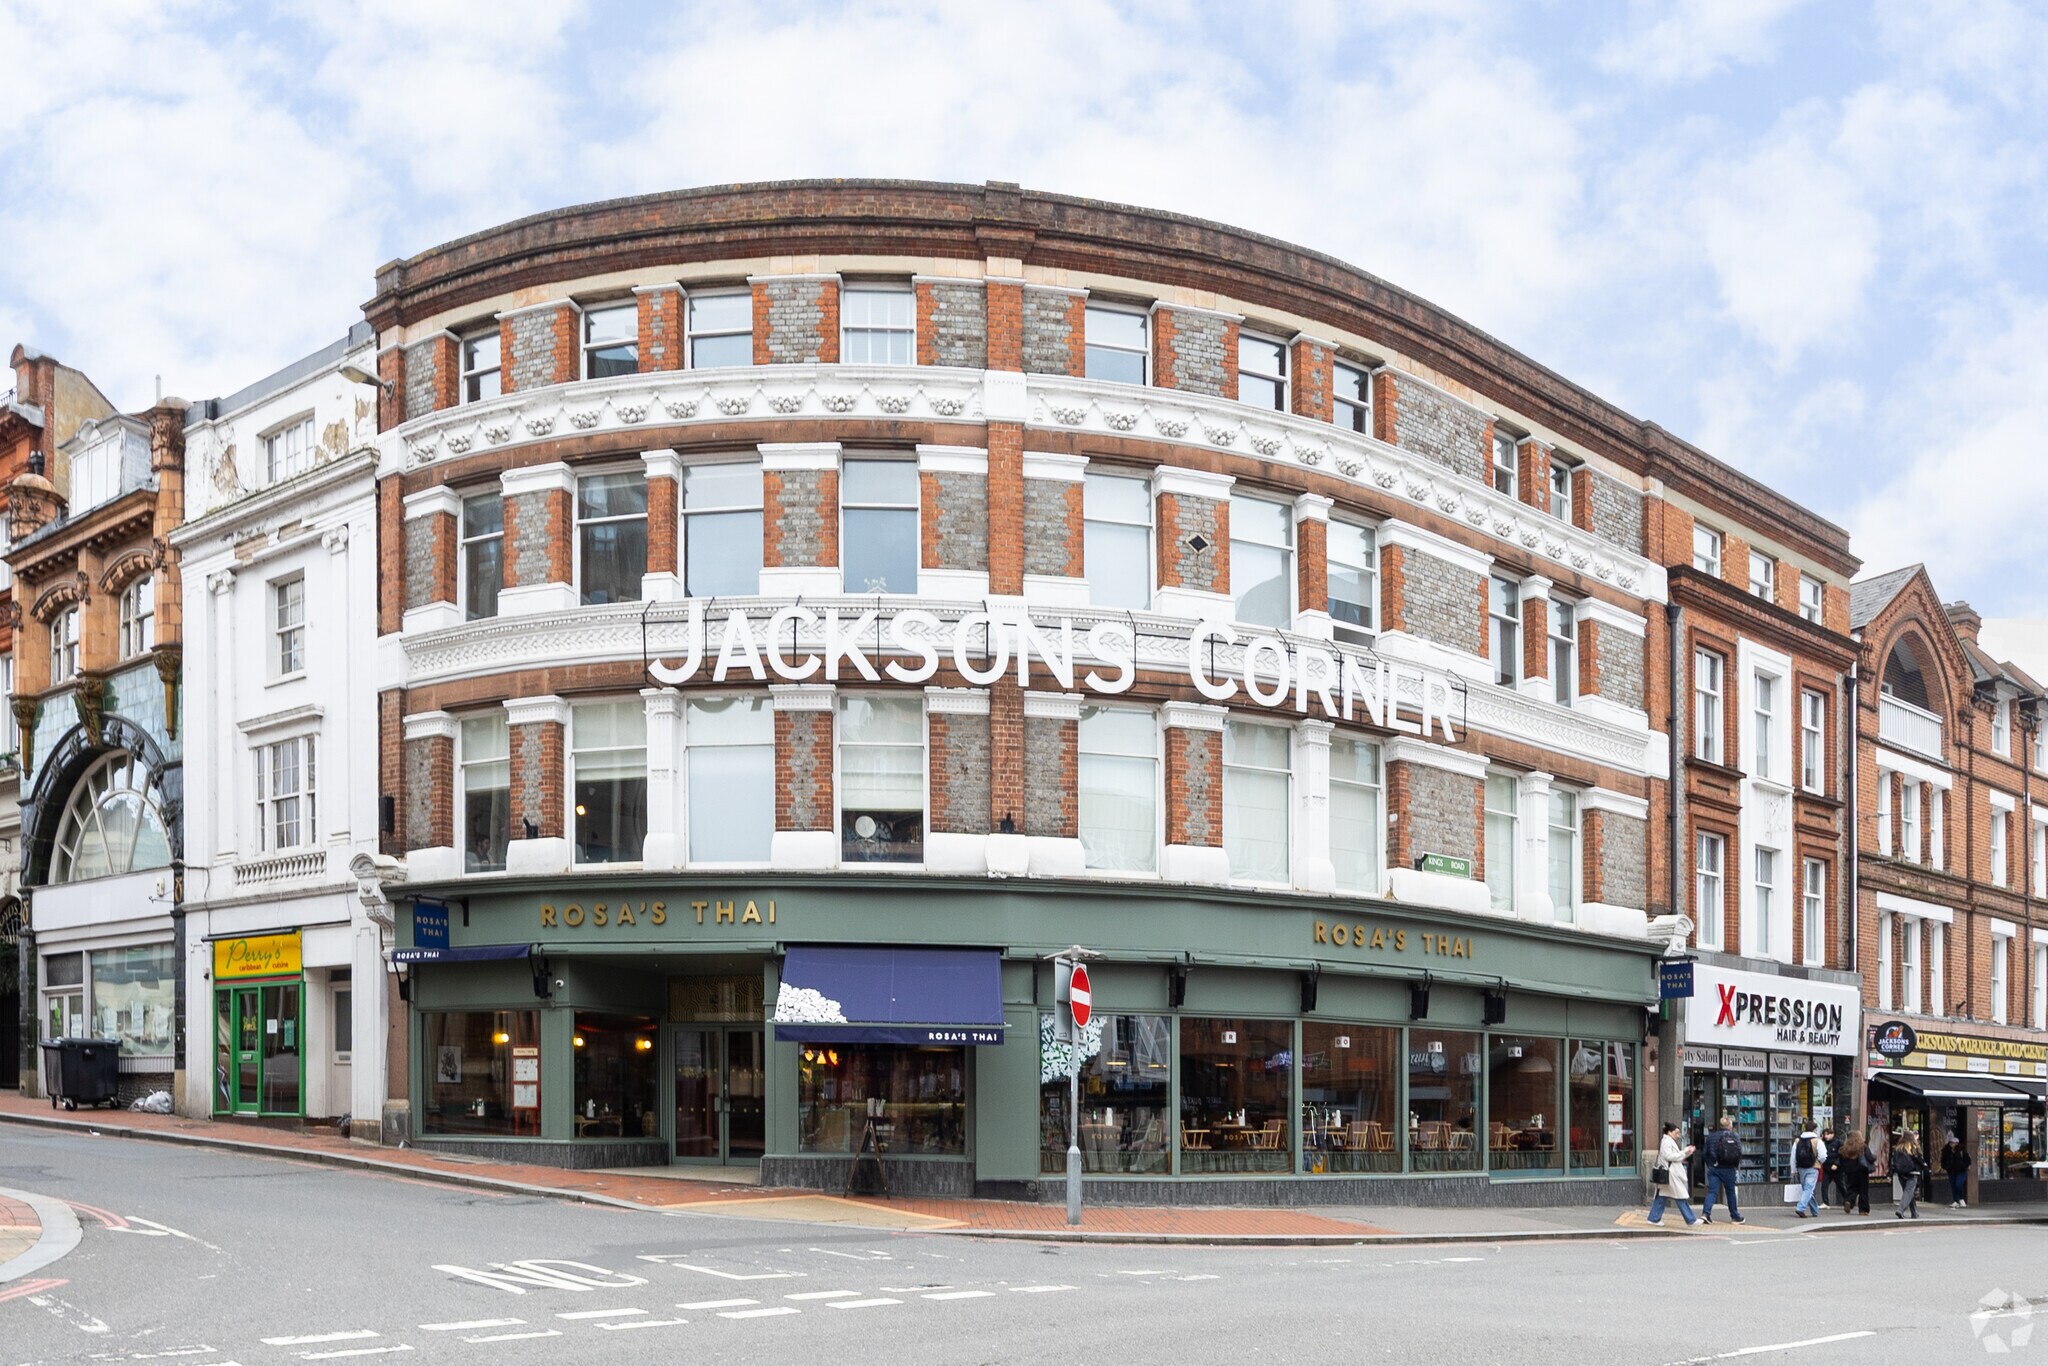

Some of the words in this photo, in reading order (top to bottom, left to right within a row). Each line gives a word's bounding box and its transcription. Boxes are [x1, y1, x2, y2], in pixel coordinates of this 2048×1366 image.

[648, 598, 1137, 694] JACKSONS
[1189, 620, 1456, 742] CORNER
[1428, 857, 1444, 867] KINGS
[1451, 860, 1466, 871] ROAD
[540, 900, 667, 927] ROSA'S
[691, 899, 776, 924] THAI
[416, 915, 448, 927] ROSA'S
[422, 927, 443, 937] THAI
[1314, 920, 1407, 951] ROSA'S
[1422, 933, 1474, 959] THAI
[226, 939, 282, 970] Perry's
[396, 951, 421, 960] ROSA'S
[423, 950, 440, 959] THAI
[272, 961, 289, 969] cuisine
[1661, 972, 1692, 981] ROSA'S
[1666, 981, 1687, 990] THAI
[1716, 983, 1843, 1032] XPRESSION
[928, 1032, 967, 1042] ROSA'S
[972, 1032, 998, 1042] THAI
[1776, 1028, 1798, 1042] HAIR
[1799, 1031, 1805, 1043] &
[1808, 1032, 1842, 1047] BEAUTY
[1878, 1038, 1909, 1046] JACKSONS
[1696, 1050, 1718, 1064] Salon
[1723, 1054, 1741, 1067] Hair
[1743, 1056, 1764, 1069] Salon
[1773, 1058, 1788, 1070] Nail
[1792, 1060, 1806, 1071] Bar
[1812, 1060, 1831, 1071] SALON
[1091, 1133, 1121, 1141] ROSA'S
[1223, 1134, 1248, 1142] ROSA'
[430, 1258, 649, 1295] NO
